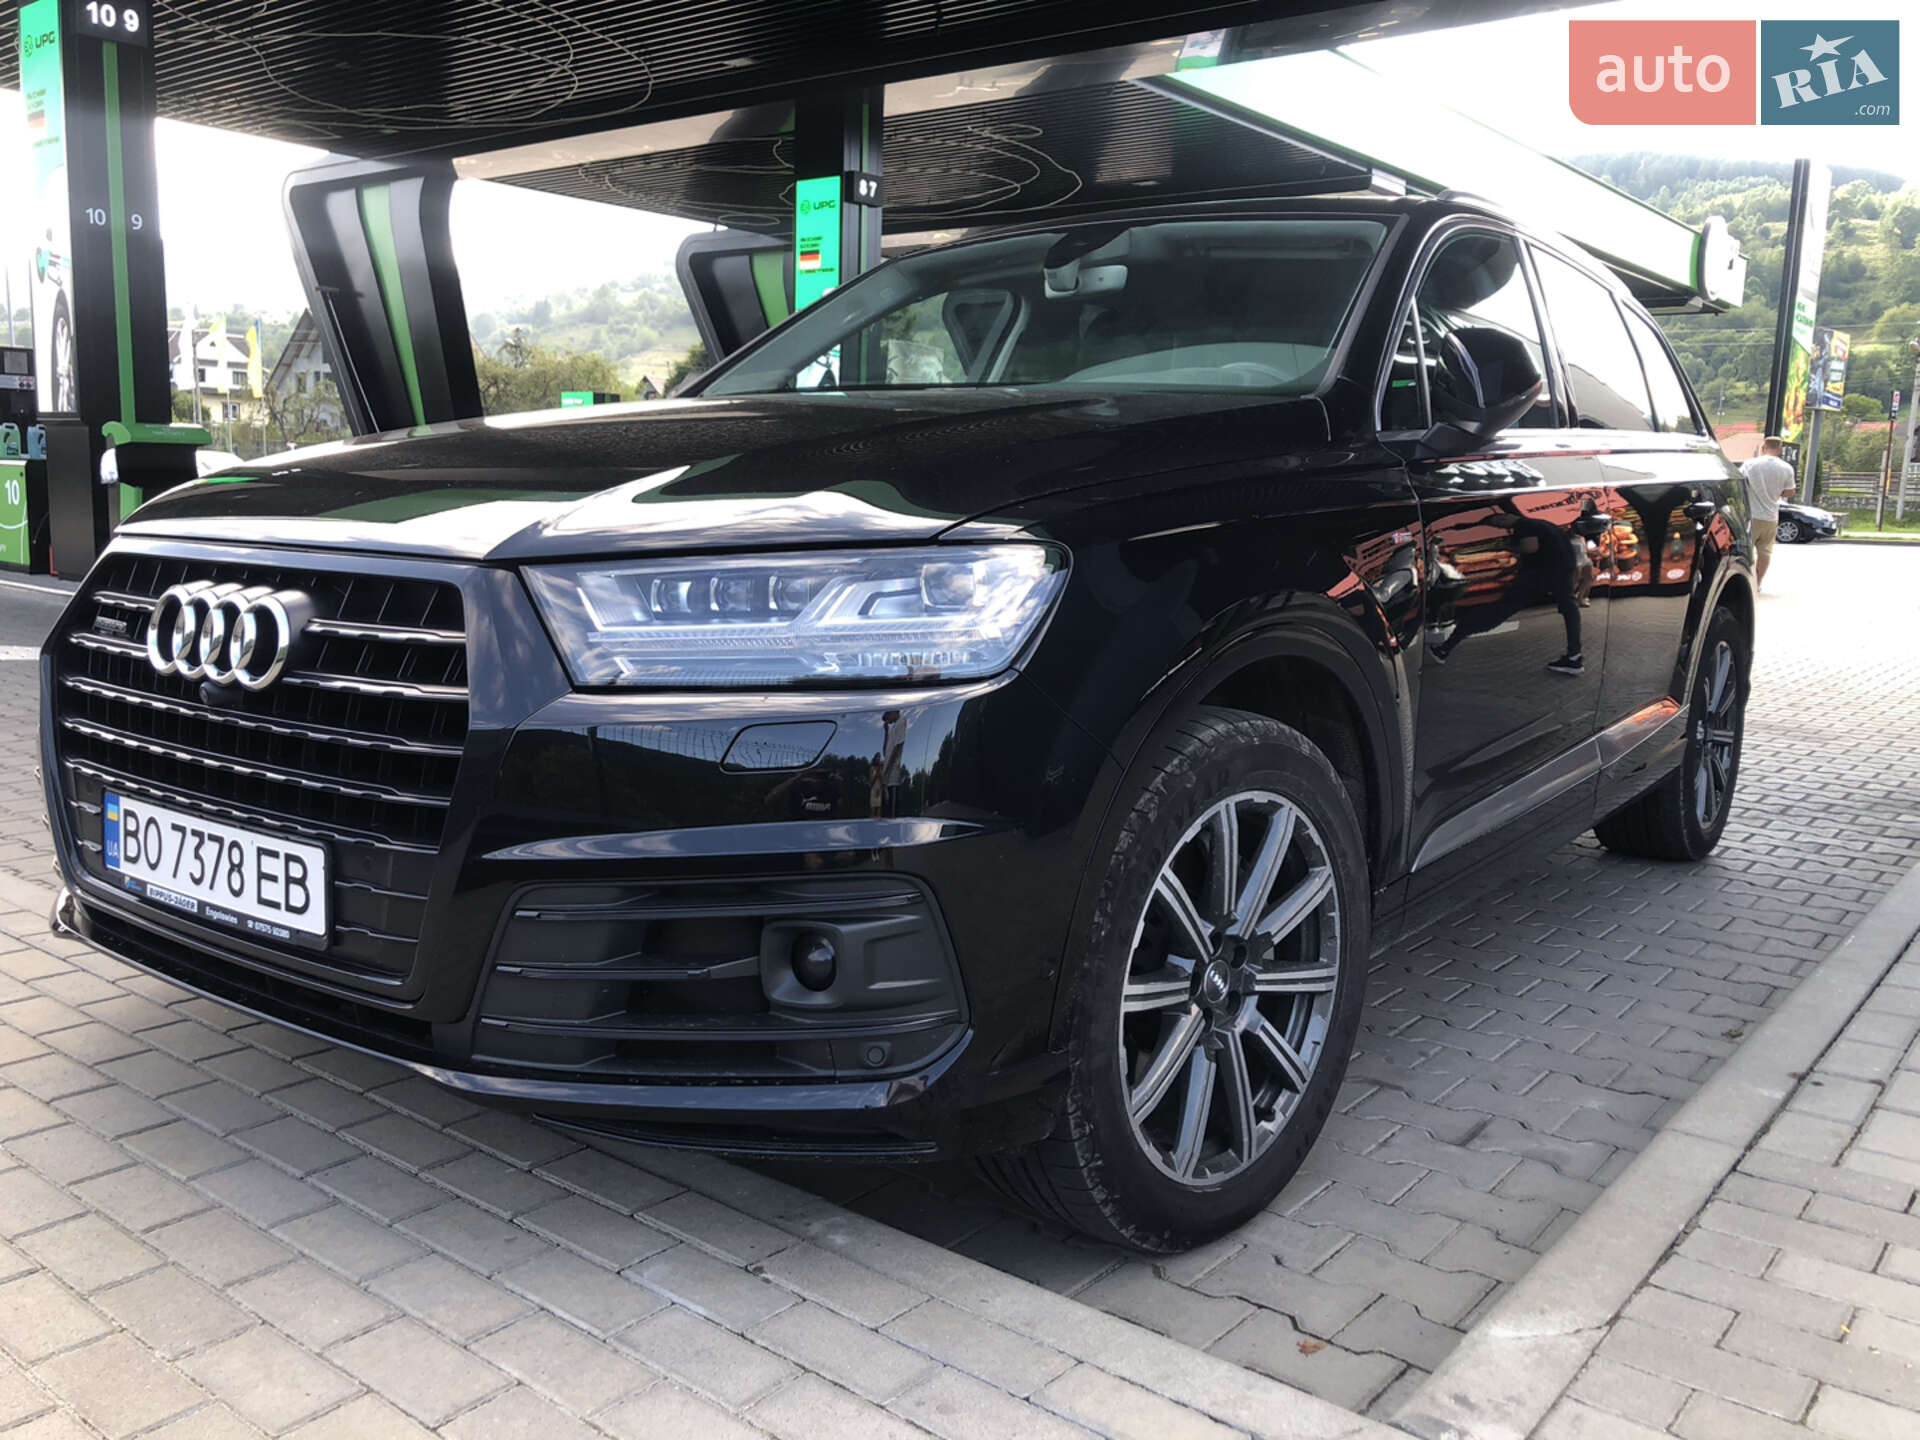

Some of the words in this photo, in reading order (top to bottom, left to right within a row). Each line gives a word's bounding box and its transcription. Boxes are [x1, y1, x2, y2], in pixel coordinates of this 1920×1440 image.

[86, 1, 117, 27] 10
[123, 9, 140, 32] 9
[35, 31, 56, 48] UPG
[85, 207, 106, 226] 10
[131, 214, 143, 230] 9
[4, 479, 20, 506] 10
[123, 808, 162, 871] BO
[171, 822, 245, 898] 7378
[257, 846, 311, 915] EB
